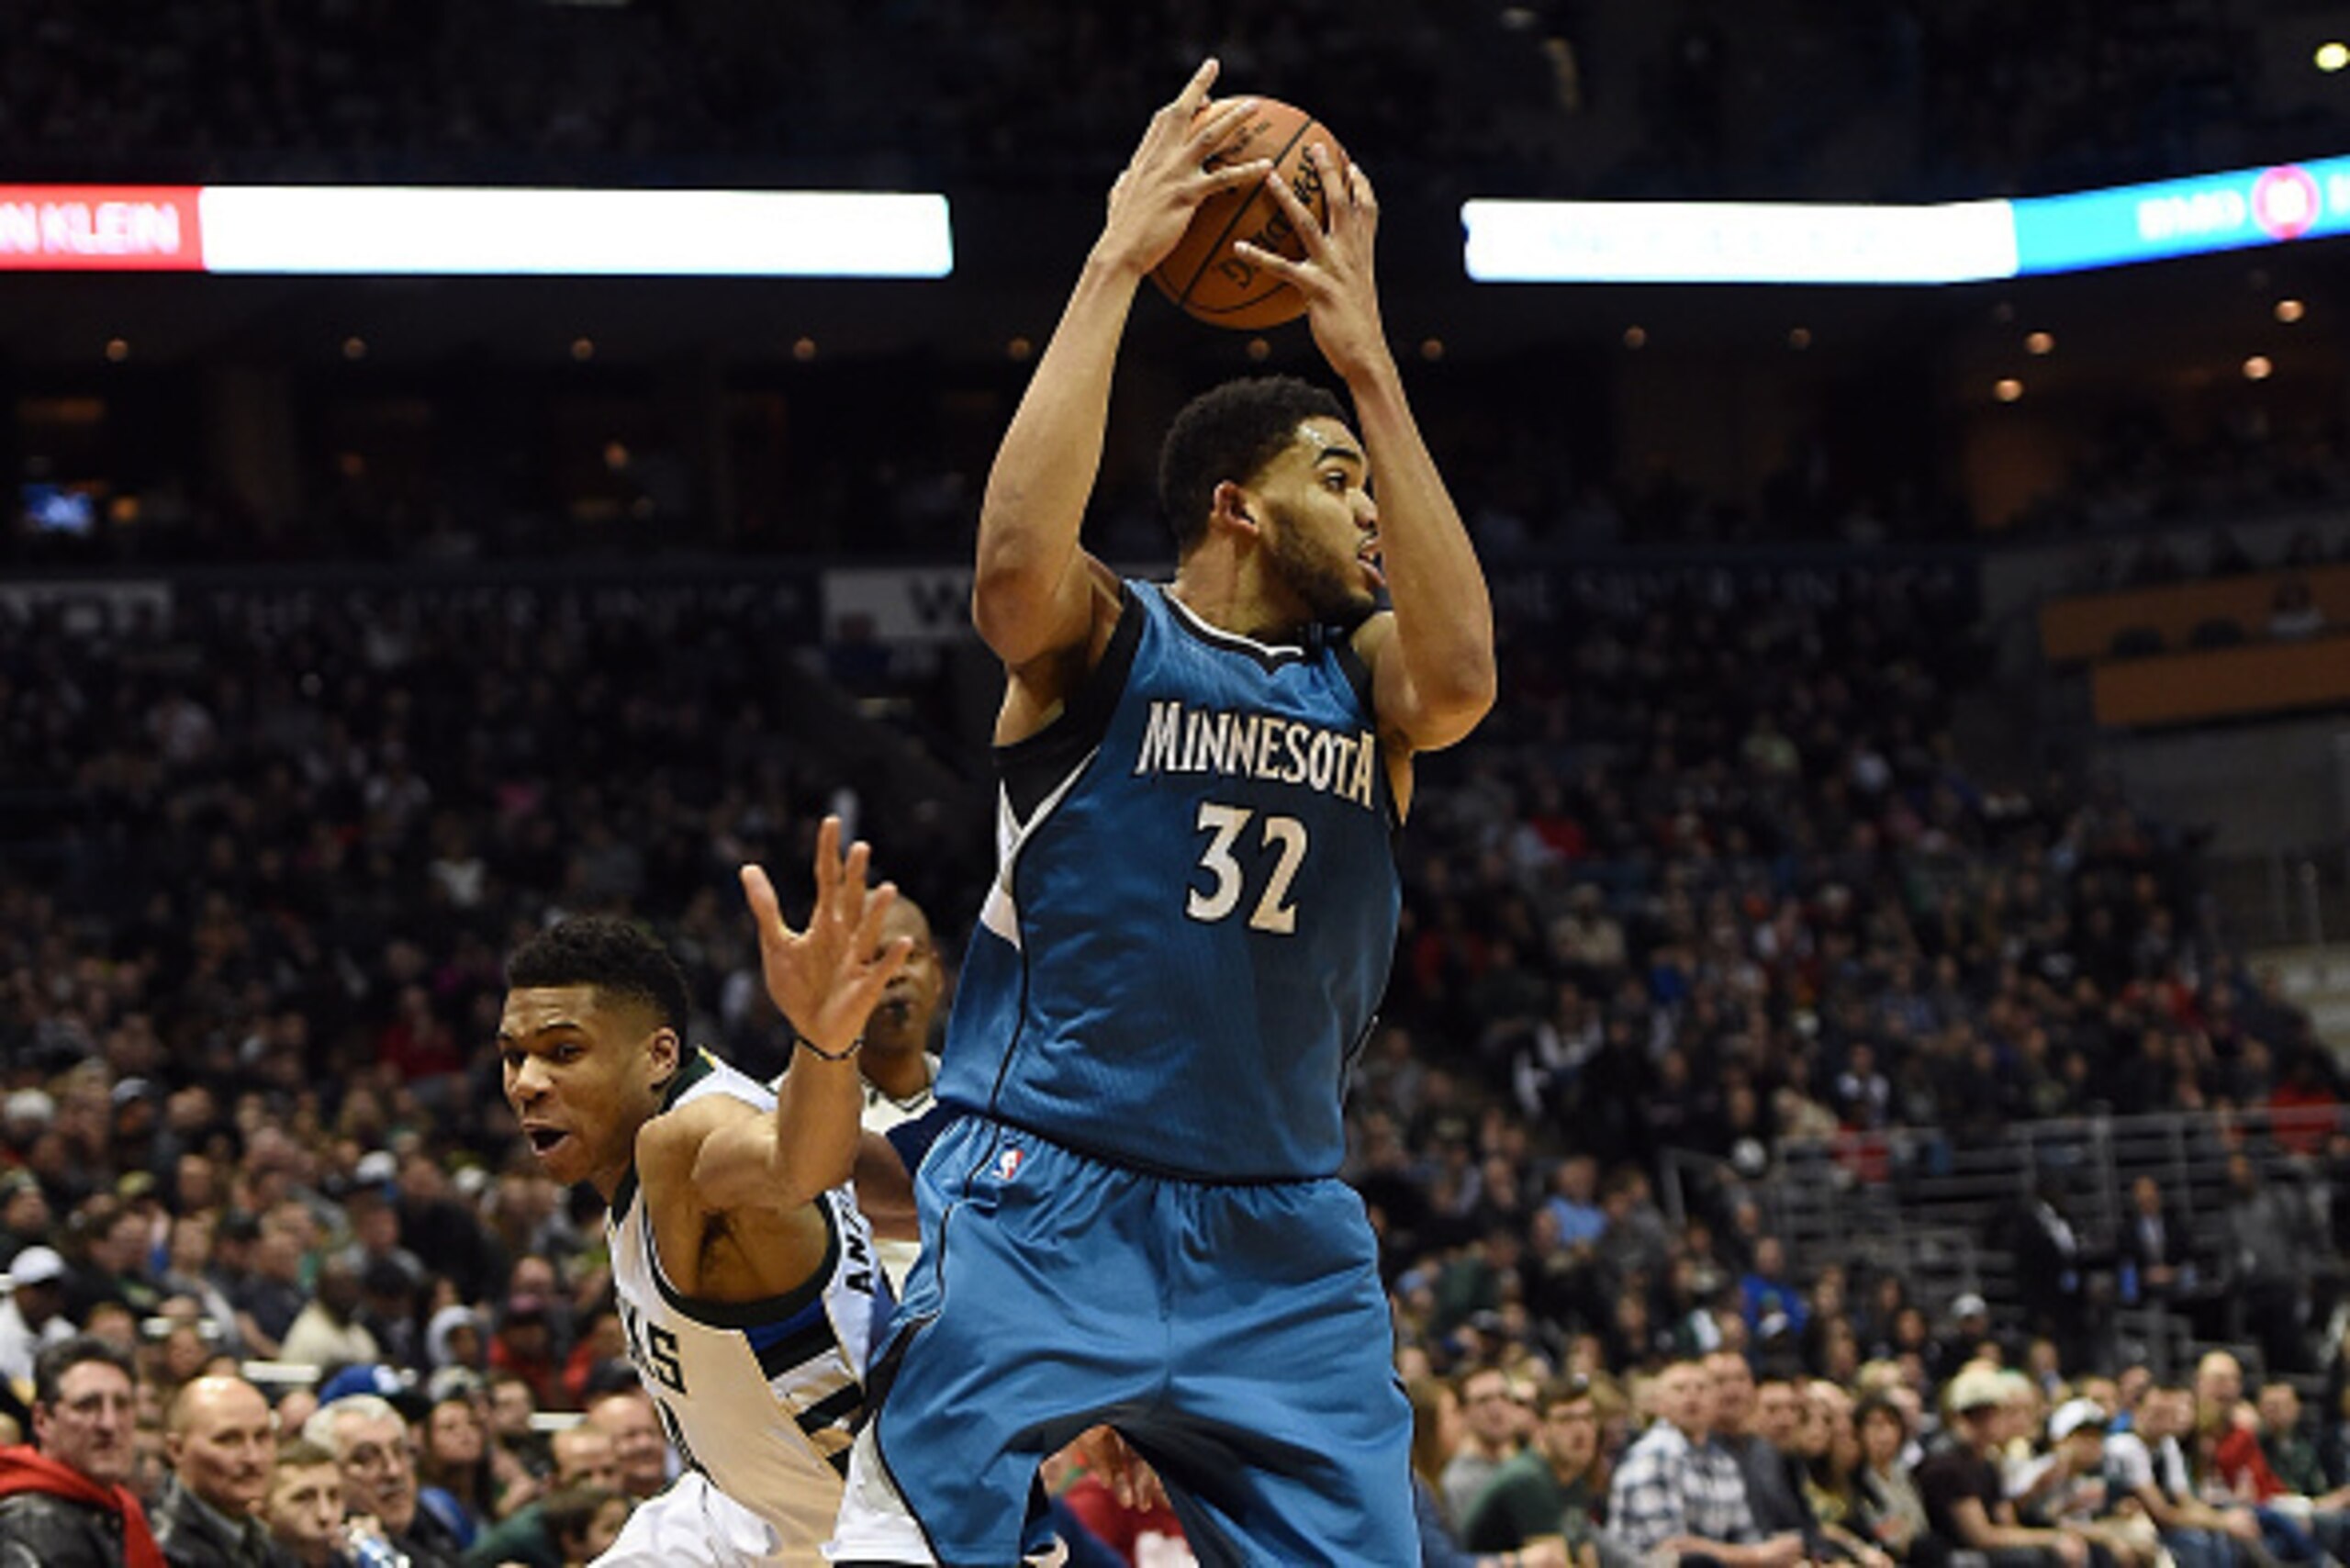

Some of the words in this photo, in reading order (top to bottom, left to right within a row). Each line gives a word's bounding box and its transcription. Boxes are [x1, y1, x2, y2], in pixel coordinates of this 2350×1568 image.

[39, 201, 180, 256] KLEIN
[1135, 701, 1375, 811] MINNESOTA
[1186, 801, 1308, 935] 32
